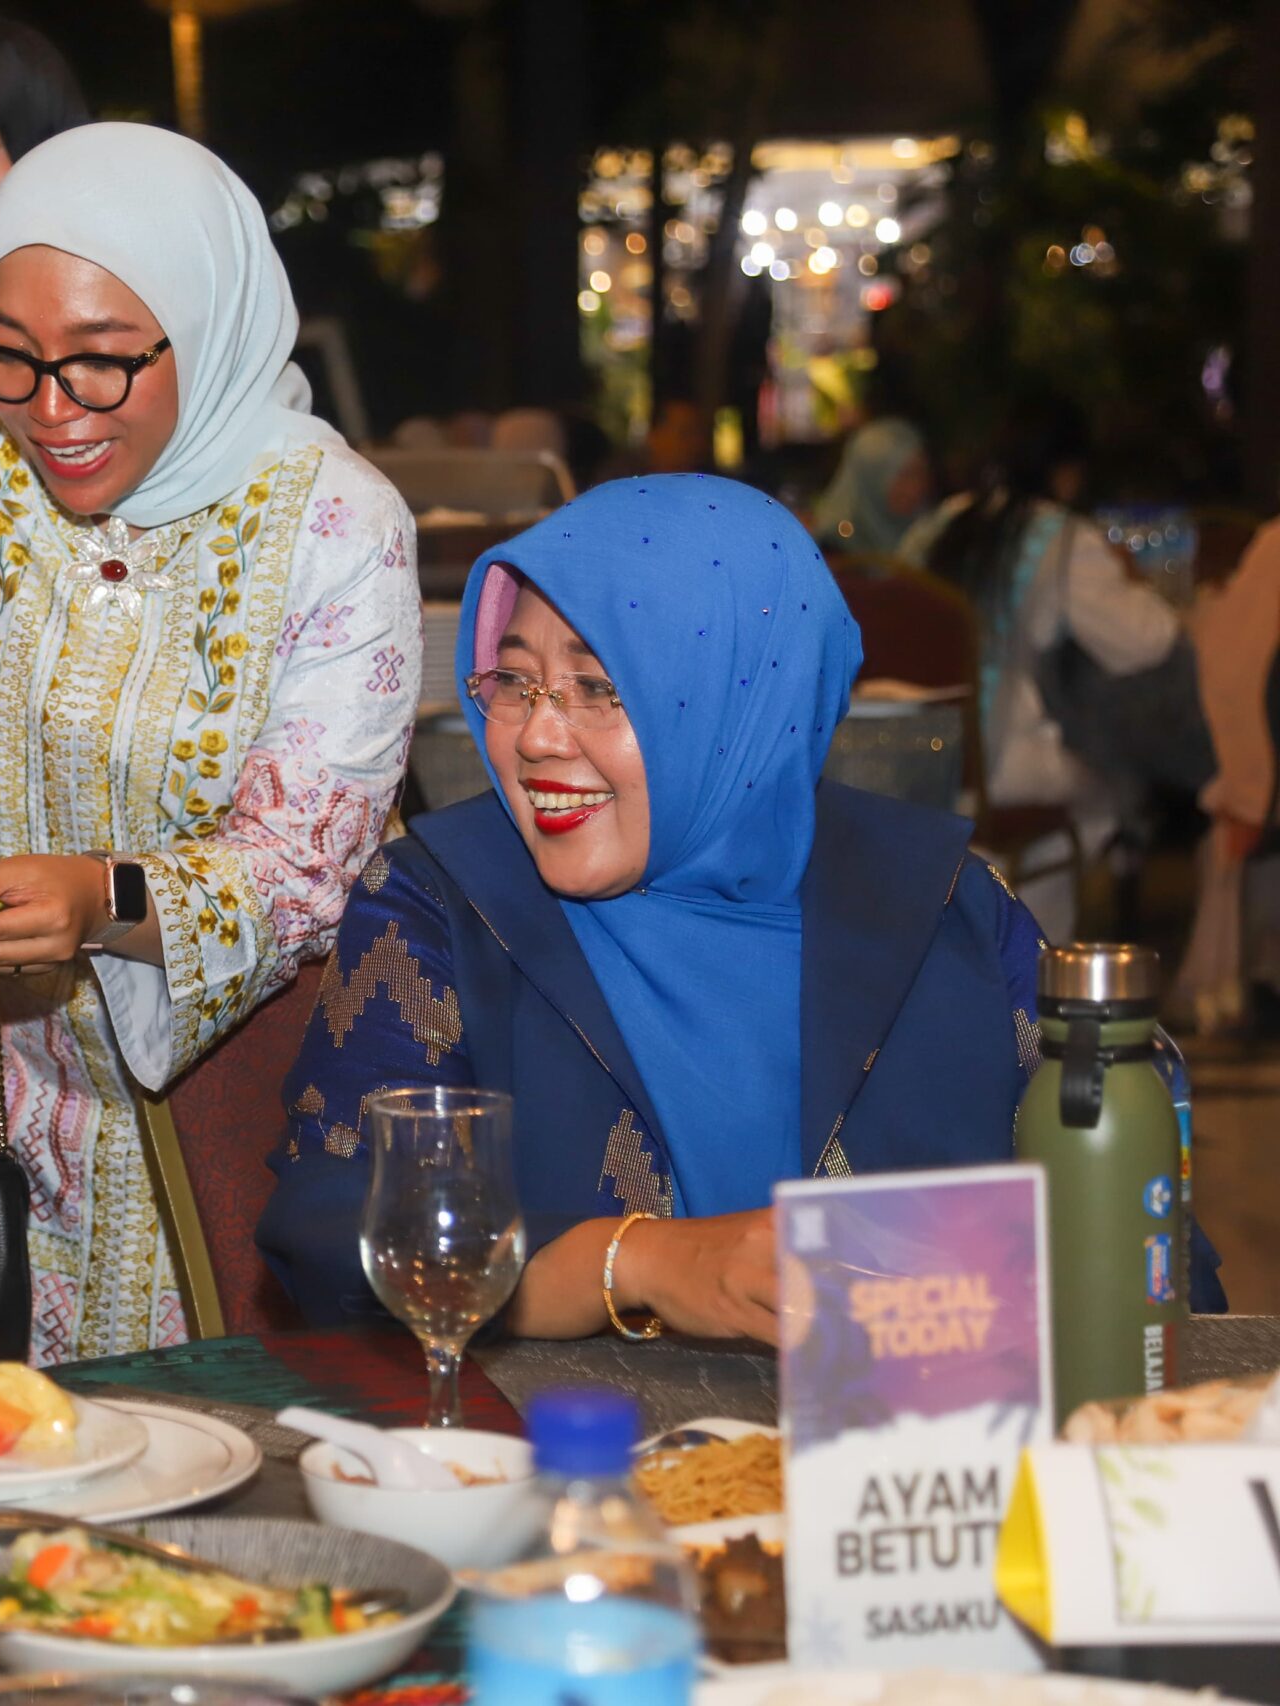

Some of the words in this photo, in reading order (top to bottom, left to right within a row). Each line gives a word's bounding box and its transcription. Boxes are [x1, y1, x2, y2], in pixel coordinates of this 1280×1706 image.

[849, 1274, 996, 1322] SPECIAL
[868, 1316, 992, 1358] TODAY
[858, 1467, 999, 1520] AYAM
[836, 1521, 1000, 1576] BETUT
[866, 1599, 998, 1639] SASAKU
